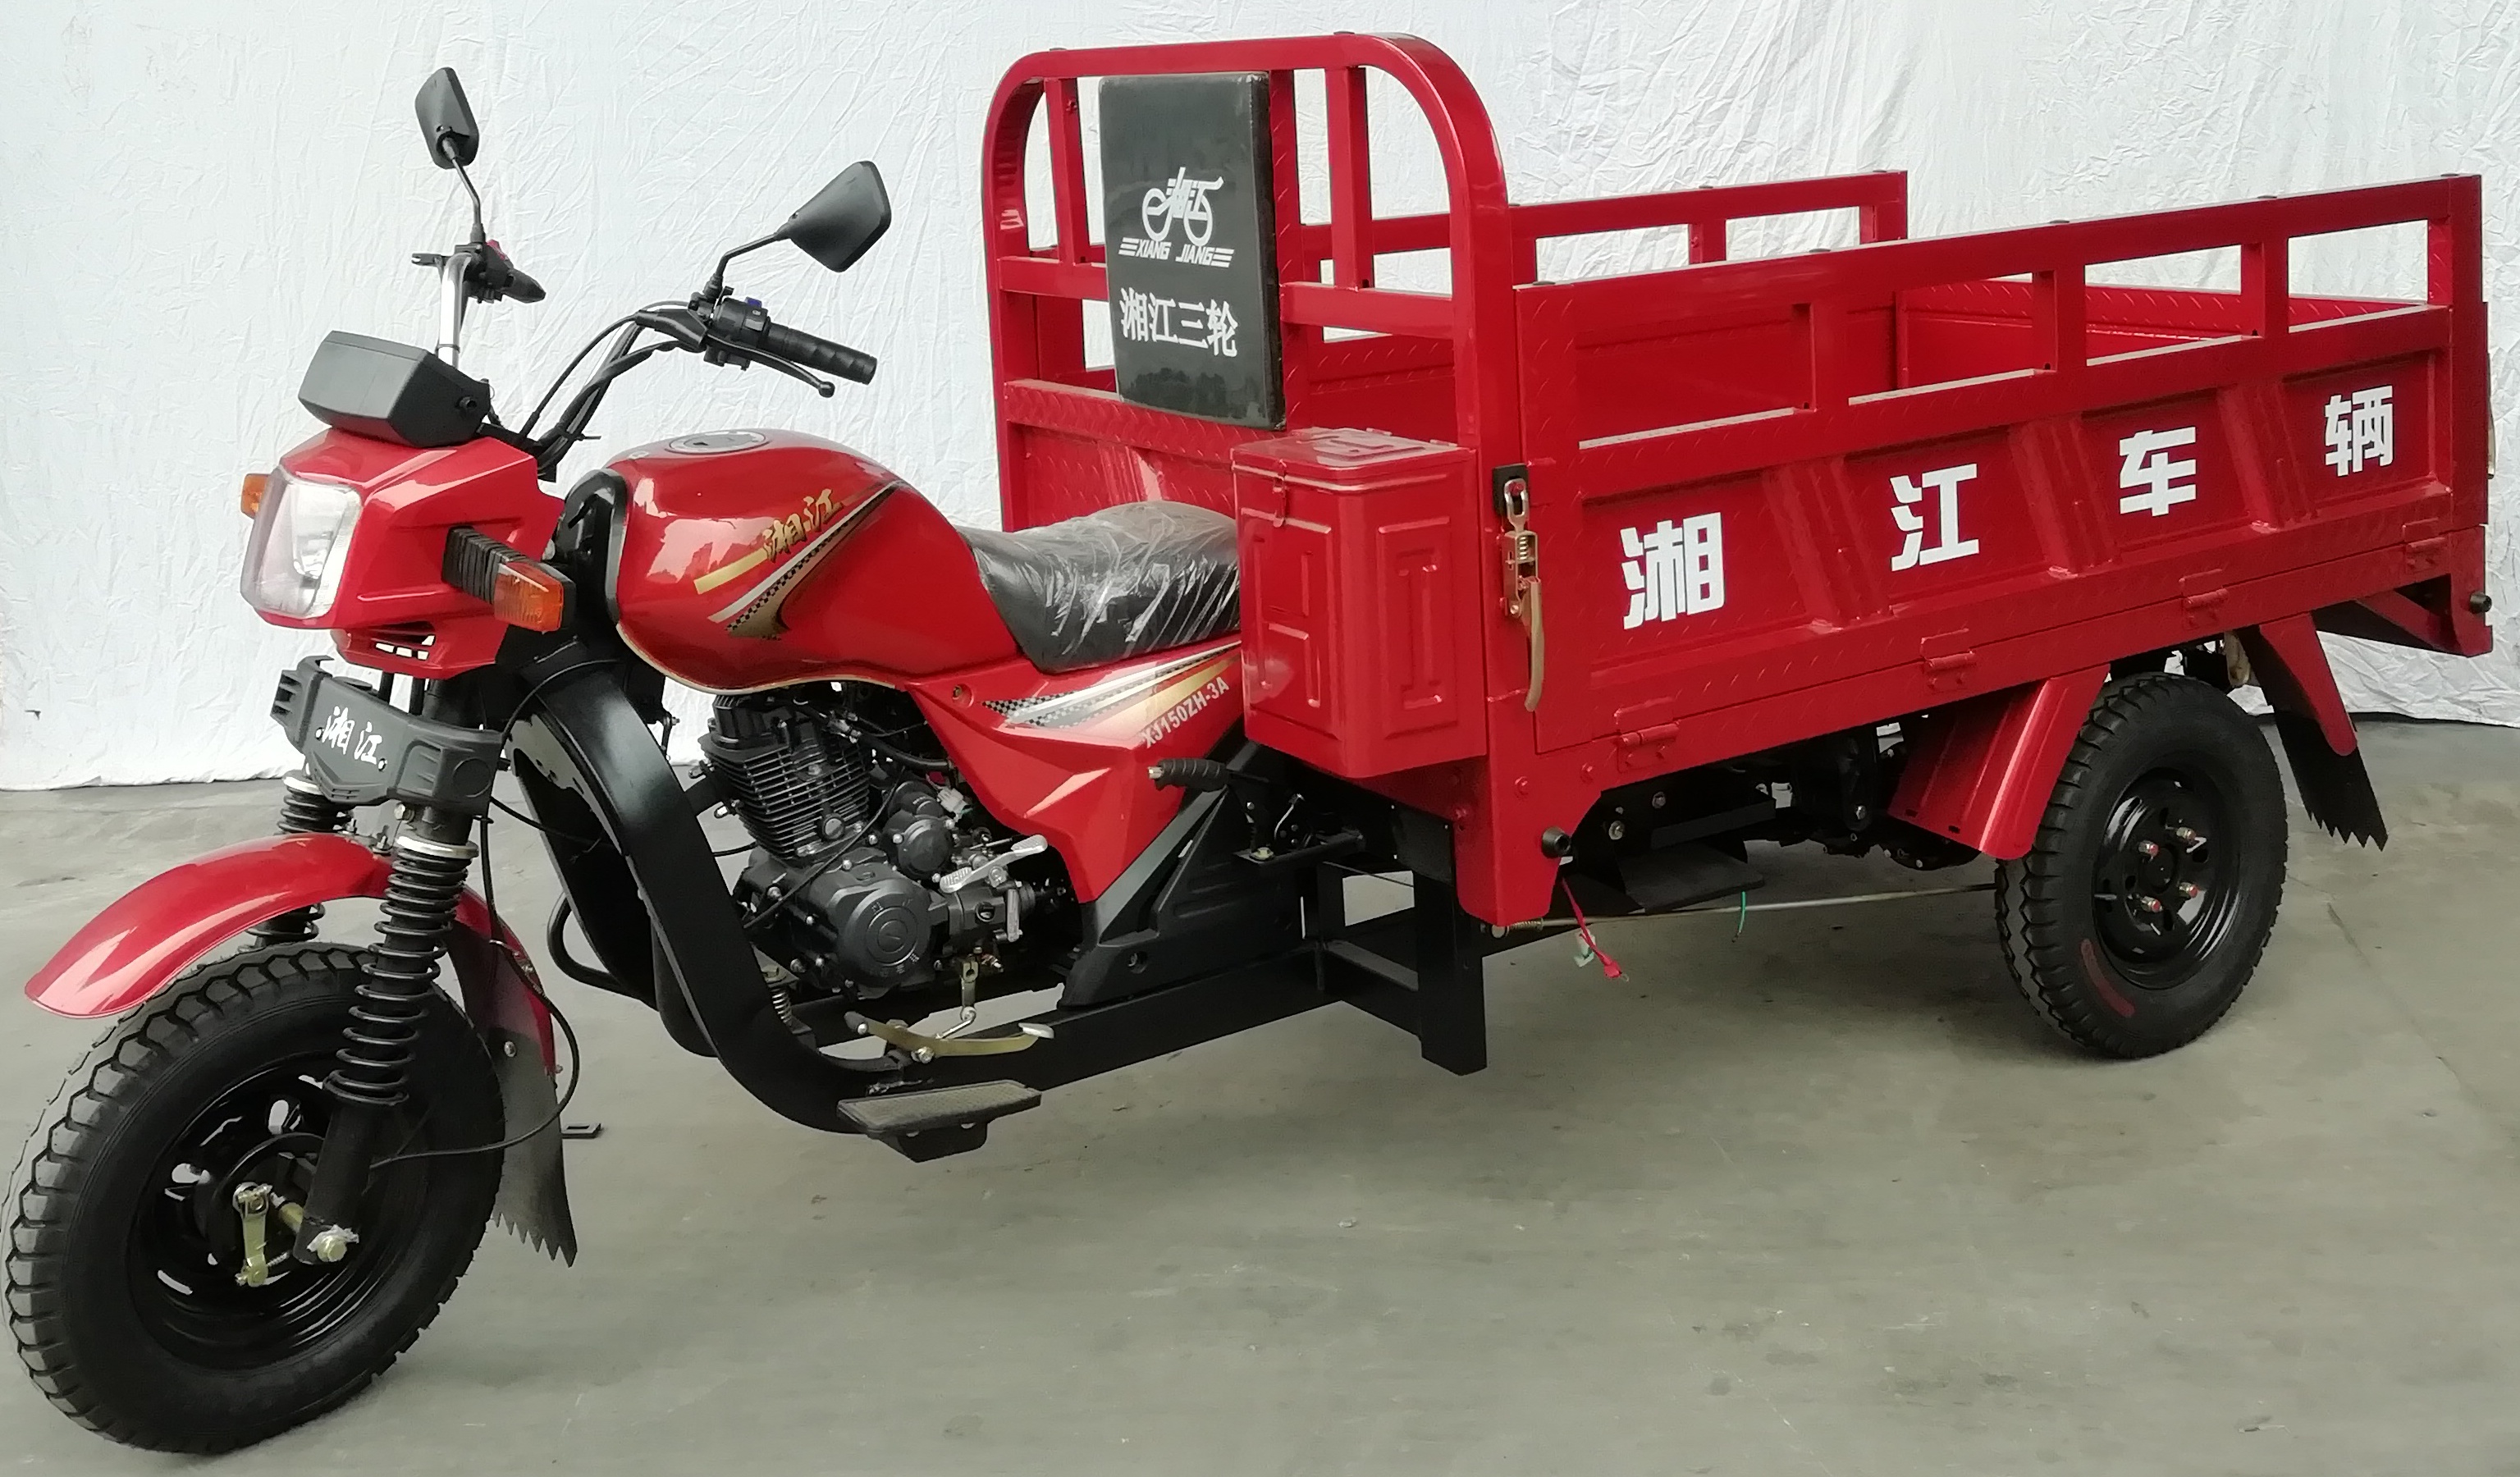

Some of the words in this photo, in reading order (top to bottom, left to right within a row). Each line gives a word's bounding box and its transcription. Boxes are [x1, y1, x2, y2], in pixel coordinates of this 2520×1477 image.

[1136, 238, 1172, 260] XIANG
[1175, 243, 1215, 266] JIANG
[1119, 286, 1239, 358] 湘江三轮
[762, 487, 844, 564] 湘江
[321, 706, 383, 766] 湘江
[1141, 676, 1229, 748] XJ150ZH-3A
